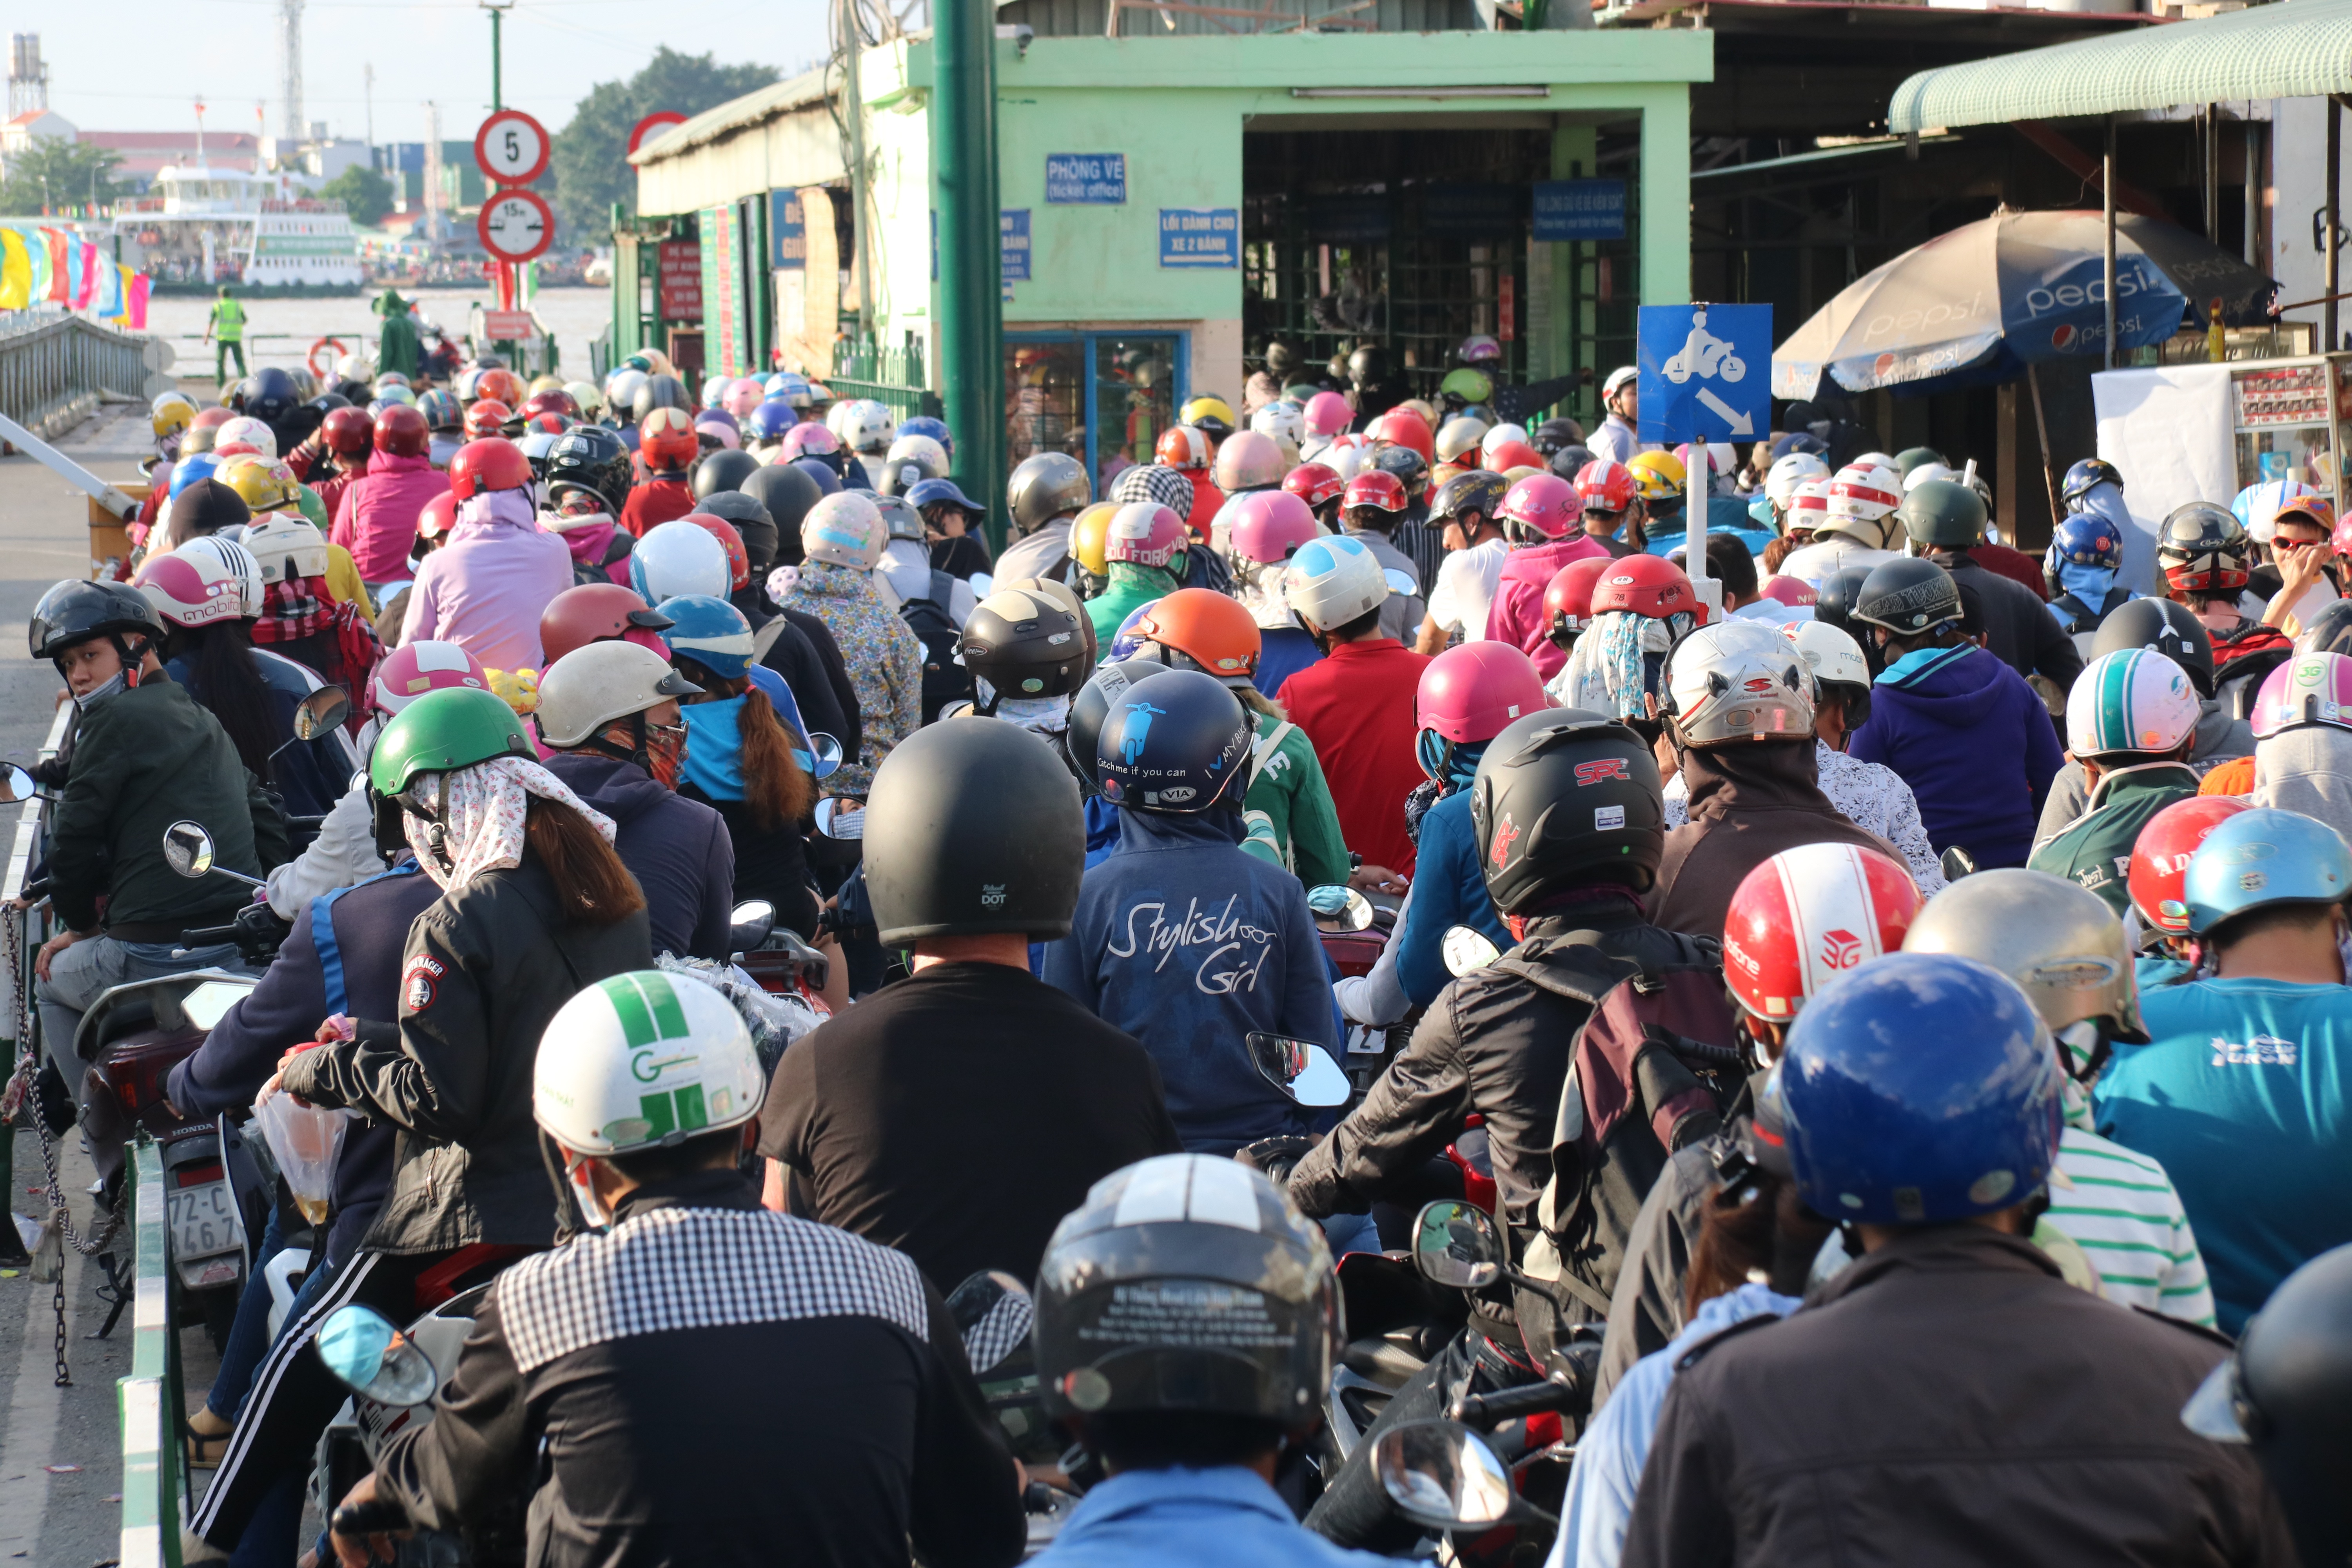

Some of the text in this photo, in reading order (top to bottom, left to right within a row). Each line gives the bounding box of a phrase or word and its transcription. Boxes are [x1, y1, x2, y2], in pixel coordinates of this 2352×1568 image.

[505, 131, 519, 162] 5
[1049, 156, 1100, 180] PHÒNG
[1049, 181, 1124, 201] (ticket office)
[1214, 217, 1234, 230] CHO
[1171, 235, 1226, 251] XE 2 BÁNH
[1864, 292, 1981, 342] pepsi
[2298, 666, 2322, 677] 3G
[1205, 719, 1247, 779] I MY BIKE
[1098, 757, 1114, 771] Catch
[1115, 765, 1128, 774] me
[1132, 766, 1139, 775] if
[1574, 758, 1631, 786] SPC
[1165, 789, 1191, 799] VIA
[1491, 812, 1522, 871] SPC
[2076, 864, 2104, 887] Just
[982, 894, 1007, 905] DOT
[1108, 893, 1241, 973] Stylish
[419, 957, 443, 977] RACER
[1196, 941, 1270, 994] Girl
[172, 1123, 215, 1136] HONDA
